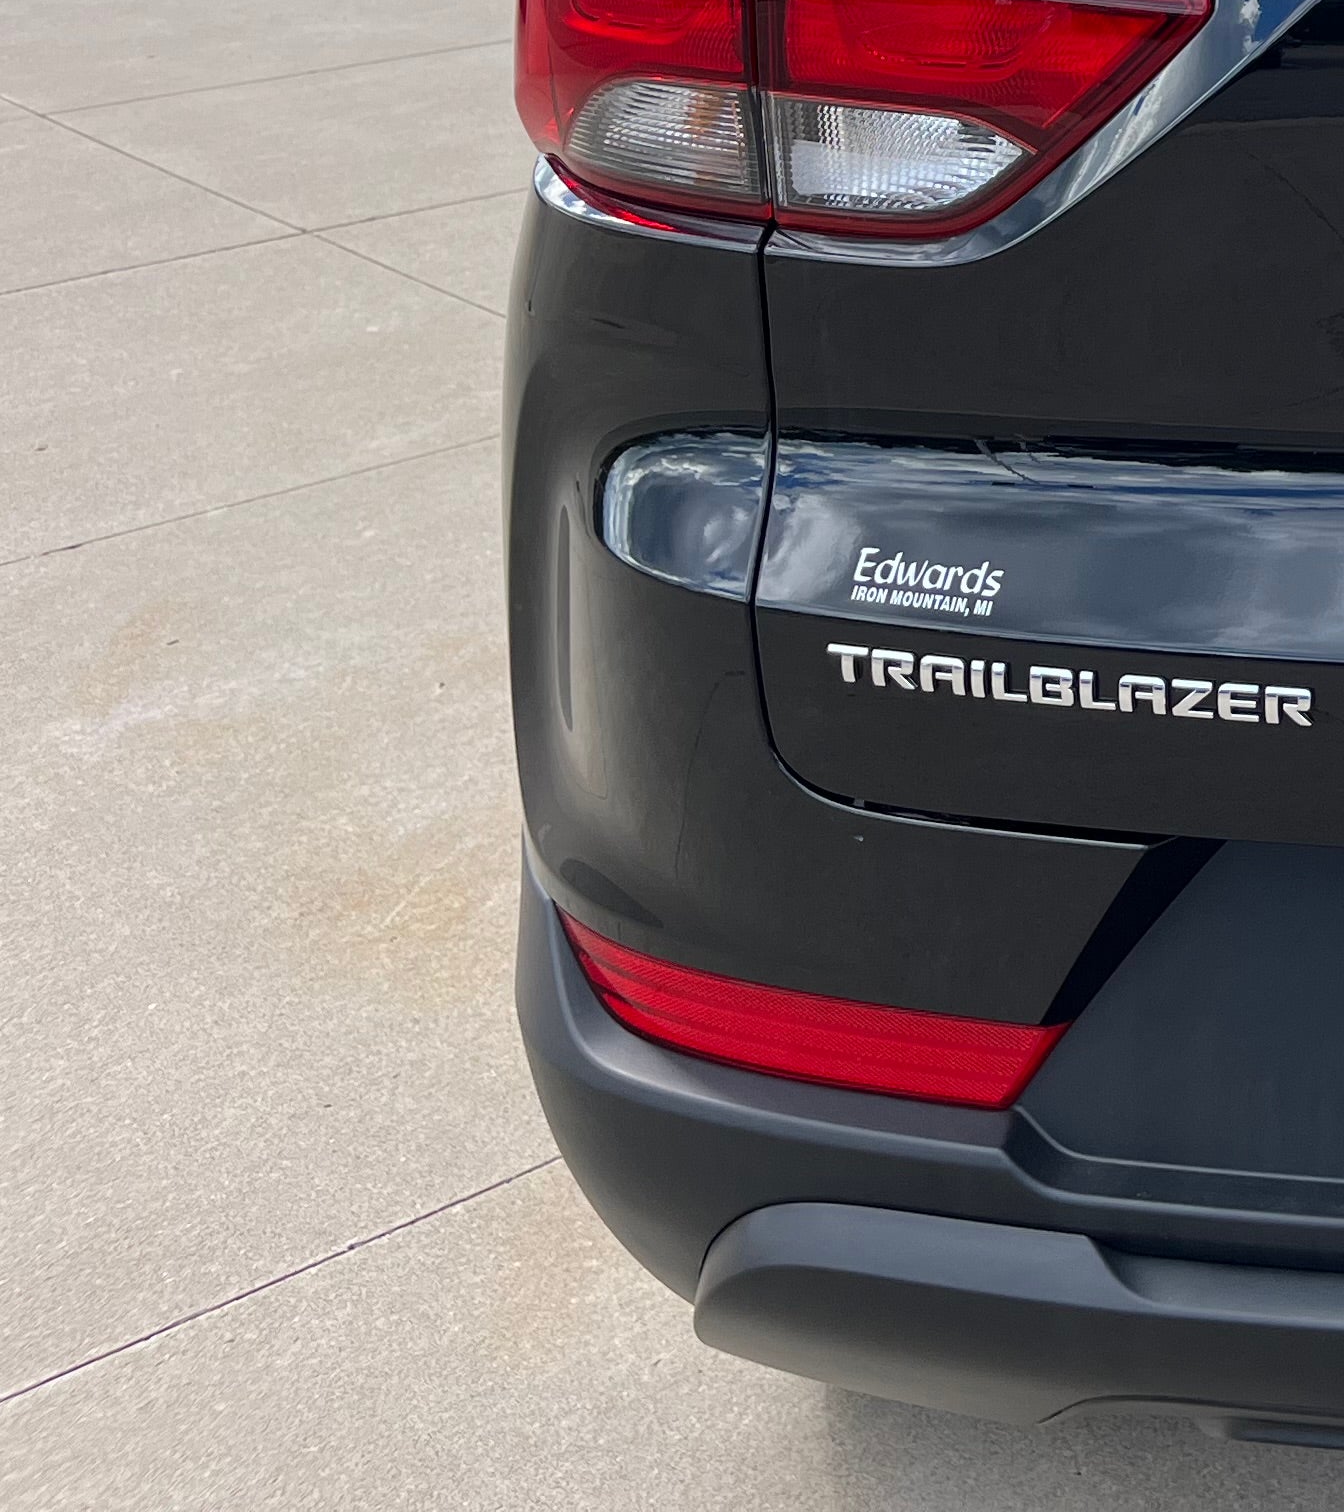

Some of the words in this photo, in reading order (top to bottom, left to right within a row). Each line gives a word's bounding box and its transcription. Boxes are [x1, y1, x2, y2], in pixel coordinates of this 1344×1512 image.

[853, 547, 1005, 597] Edwards
[850, 585, 888, 604] IRON
[889, 590, 971, 617] MOUNTAIN,
[973, 599, 994, 617] MI
[826, 643, 1315, 727] TRAILBLAZER
